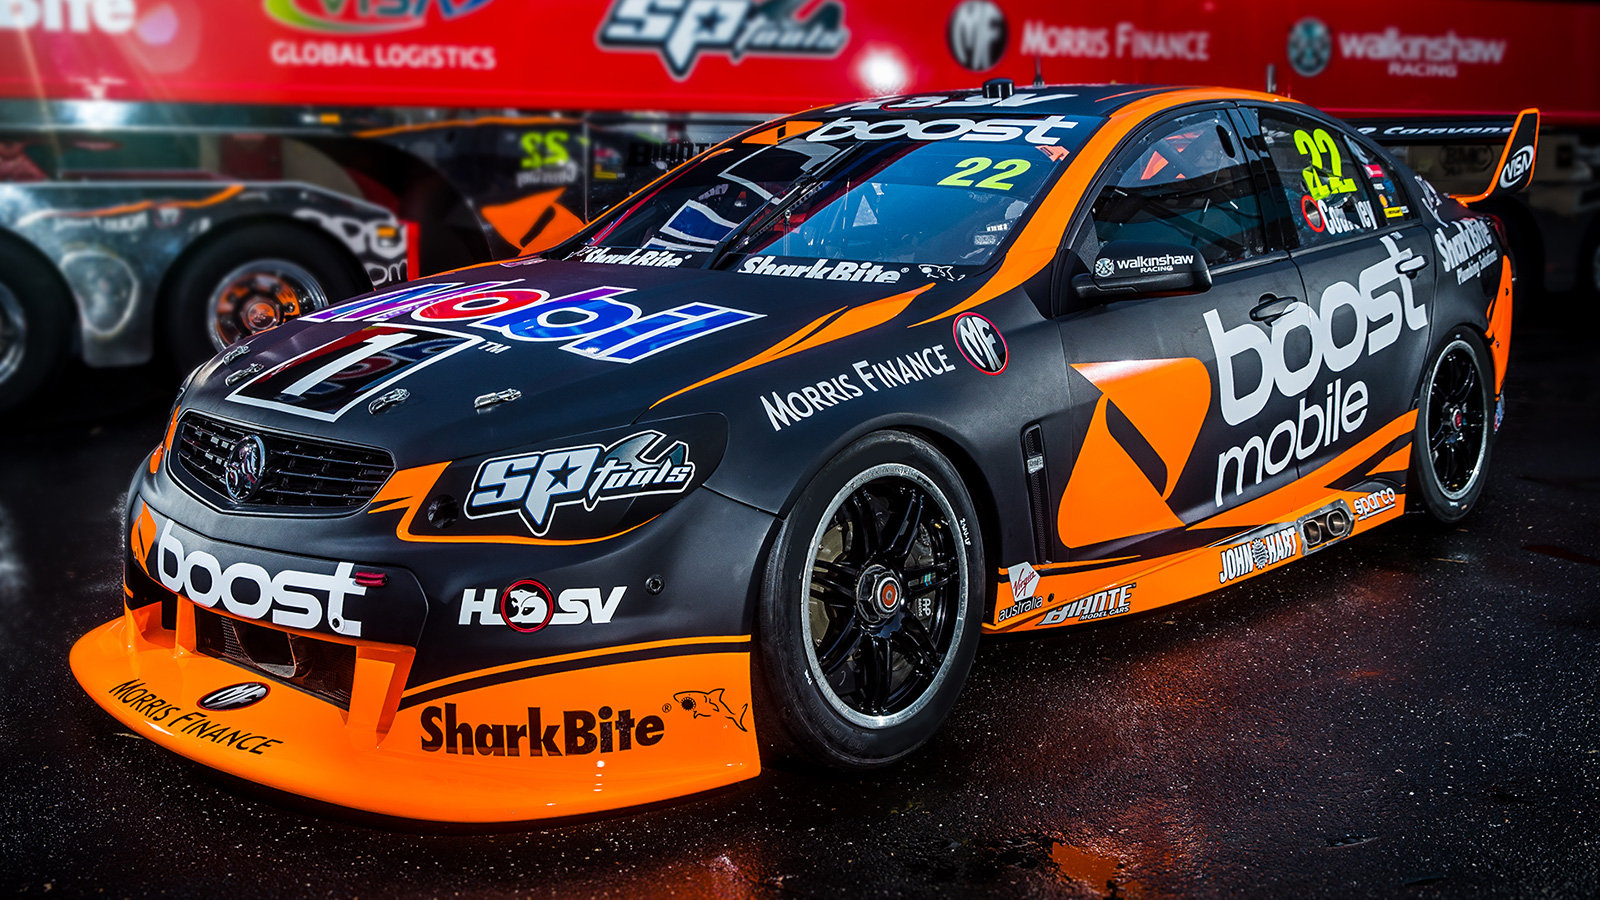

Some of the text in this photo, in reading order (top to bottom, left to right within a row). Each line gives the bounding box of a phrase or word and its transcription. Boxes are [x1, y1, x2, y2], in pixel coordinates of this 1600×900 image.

[270, 40, 496, 70] GLOBAL LOGISTICS
[1021, 20, 1208, 61] MORRIS FINANCE
[1338, 27, 1506, 64] walkinshaw
[1388, 62, 1458, 77] RACING
[806, 115, 1078, 145] boost
[936, 157, 1032, 191] 22
[1293, 128, 1358, 201] 22
[1116, 254, 1194, 269] walkinshaw
[1140, 265, 1174, 273] RACING
[296, 278, 767, 364] Mobil
[1203, 232, 1428, 426] boost
[958, 314, 1001, 373] MF
[759, 343, 956, 431] MORRIS FINANCE
[1215, 378, 1368, 508] mobile
[472, 447, 692, 525] SP tools
[1353, 487, 1396, 516] sparco
[1218, 526, 1297, 584] JOHN HART
[157, 519, 367, 637] boost
[1012, 567, 1037, 598] Virgin
[998, 596, 1043, 622] australia
[1079, 606, 1130, 621] MODEL CARS
[108, 679, 284, 755] MORRIS FINANCE
